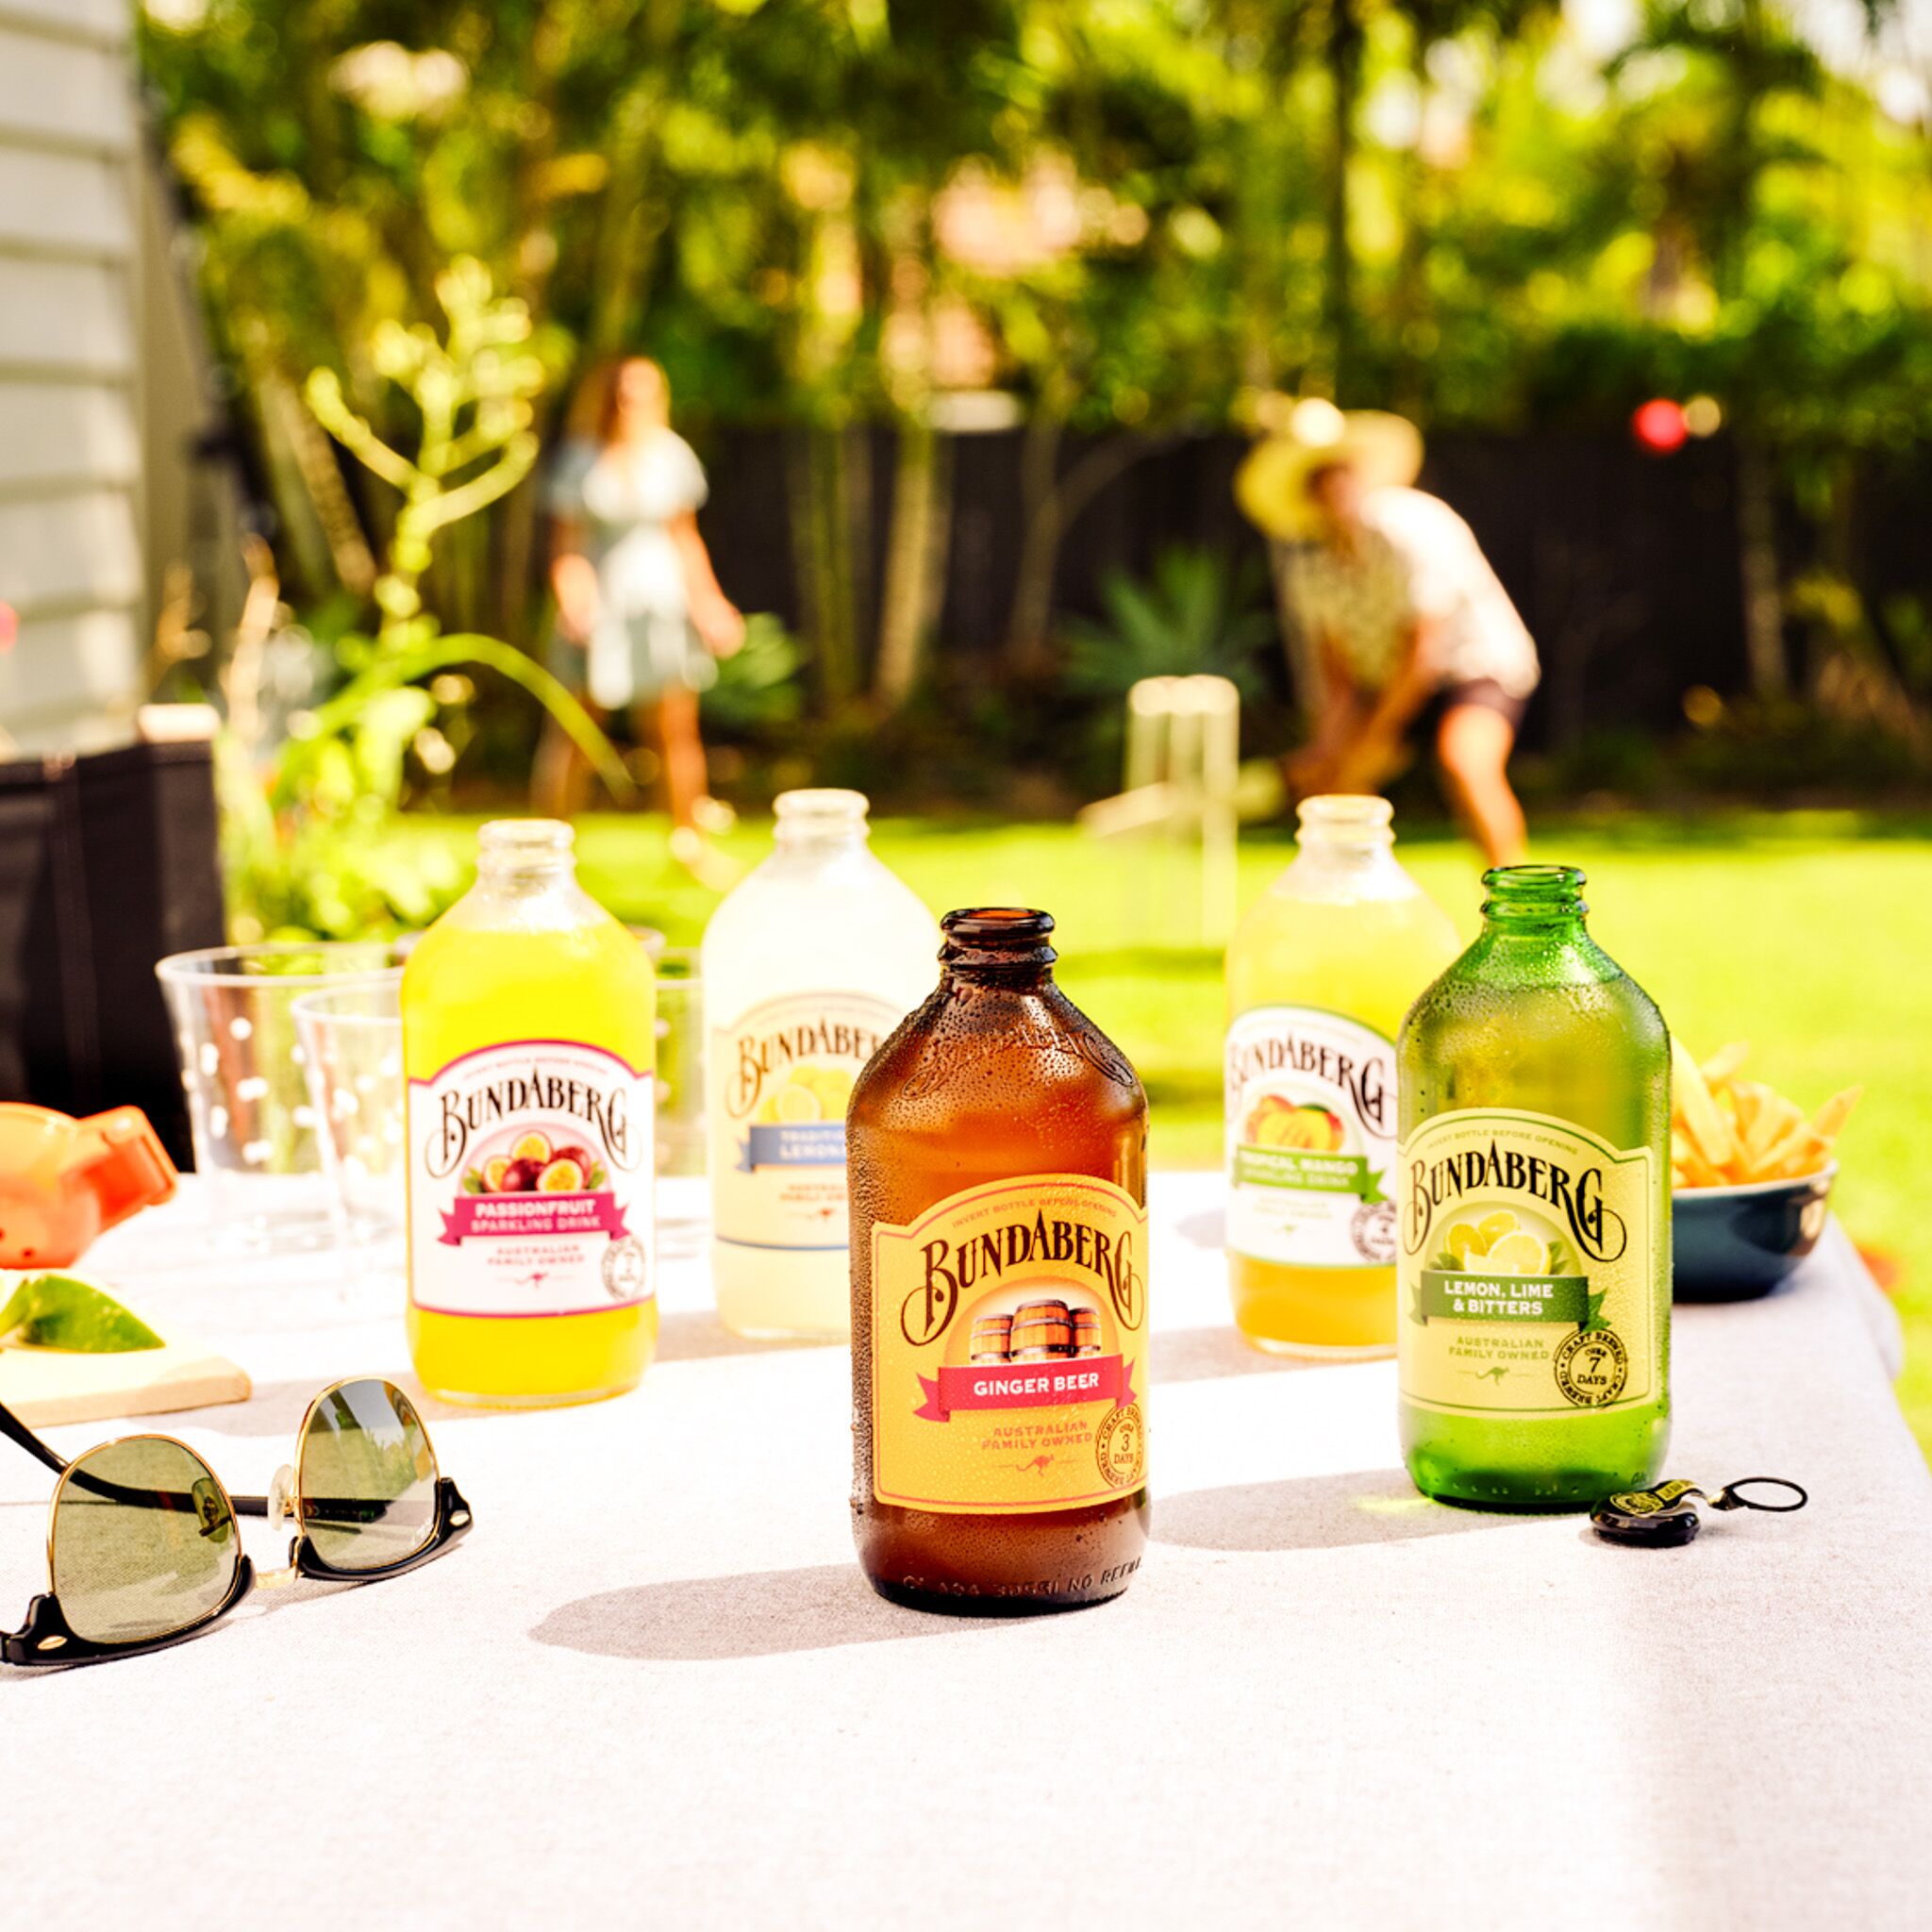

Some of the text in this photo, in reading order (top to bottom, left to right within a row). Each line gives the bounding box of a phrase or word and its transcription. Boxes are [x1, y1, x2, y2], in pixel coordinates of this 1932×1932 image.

[425, 1065, 642, 1179] BUNDABERG
[1454, 1129, 1491, 1140] BOTTLE
[1492, 1130, 1533, 1140] BEFORE
[1535, 1135, 1578, 1155] OPENING
[475, 1199, 596, 1218] PASSIONFRUIT
[1403, 1139, 1627, 1262] BUNDABERG
[952, 1208, 990, 1228] INVERT
[992, 1200, 1037, 1214] BOTTLE
[471, 1215, 601, 1233] SPARKLING DRINK
[900, 1208, 1144, 1346] BUNDABERG
[1444, 1280, 1554, 1299] LEMON, LIME
[1454, 1298, 1543, 1315] & BITTERS
[1457, 1337, 1543, 1348] AUSTRALIAN
[1562, 1332, 1623, 1364] CRAFT BREWED
[1448, 1346, 1549, 1359] FAMILY OWNED
[1590, 1357, 1601, 1374] 7
[974, 1373, 1099, 1396] GINGER BEER
[1577, 1374, 1607, 1385] DAYS
[993, 1420, 1087, 1437] AUSTRALIAN
[981, 1432, 1092, 1450] FAMILY OWNED
[1122, 1434, 1130, 1452] 3
[1114, 1454, 1134, 1464] DAYS
[1067, 1574, 1092, 1592] NO
